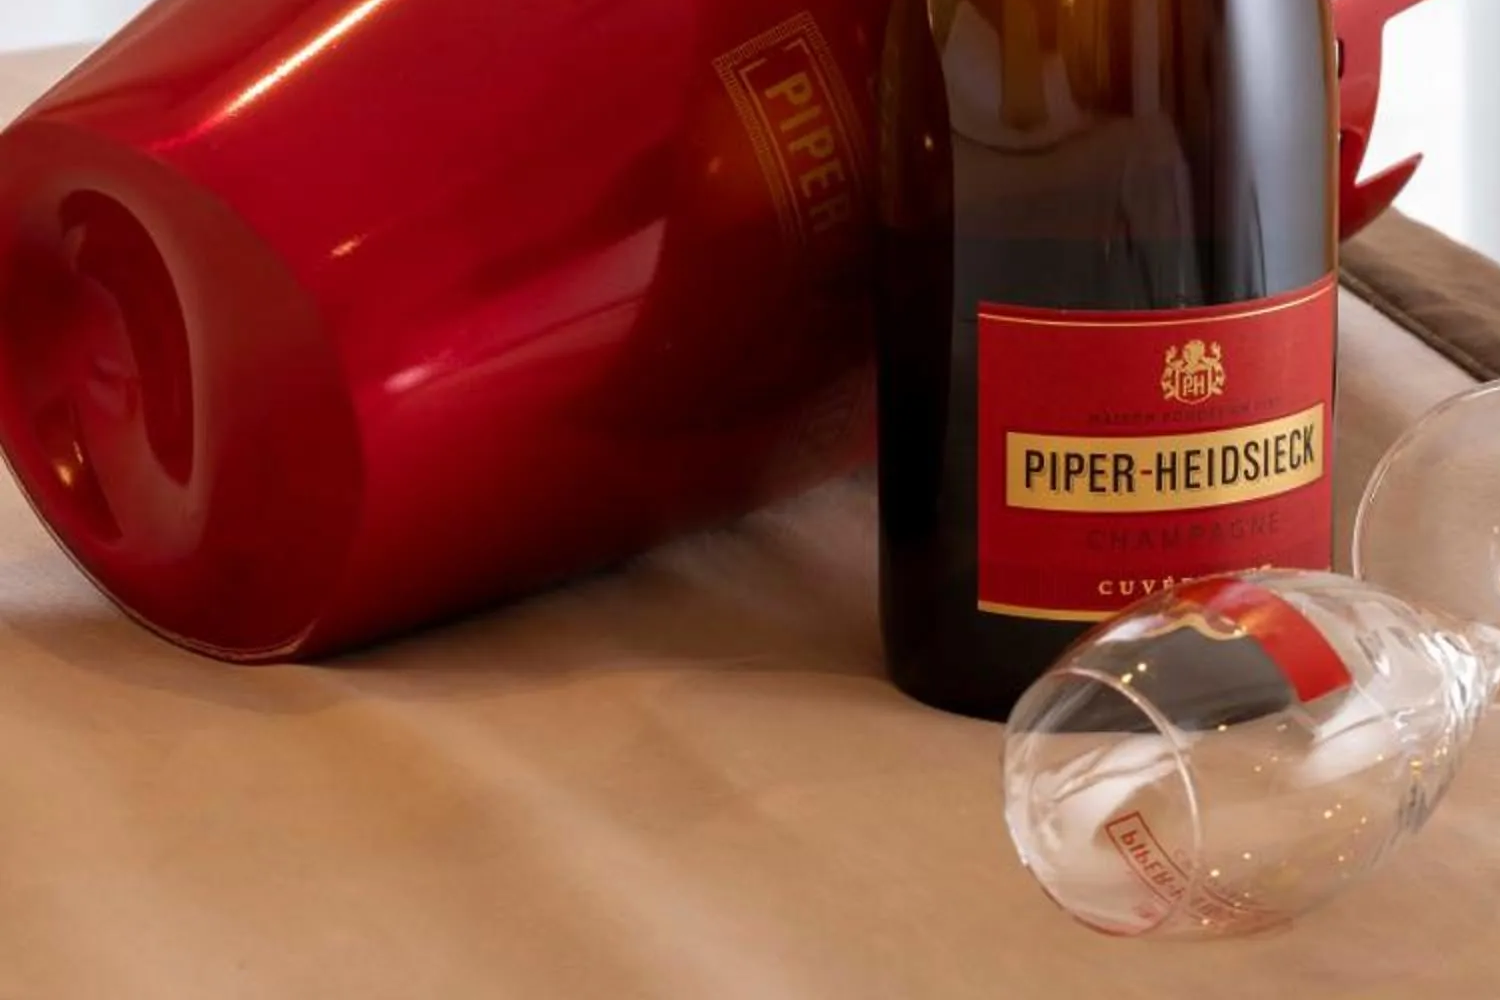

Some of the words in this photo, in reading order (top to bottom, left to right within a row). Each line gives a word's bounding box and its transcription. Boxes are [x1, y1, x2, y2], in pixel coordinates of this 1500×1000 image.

[765, 71, 850, 234] PIPER
[1024, 424, 1315, 493] PIPER-HEIDSIECK
[1098, 576, 1194, 595] CUVÉ
